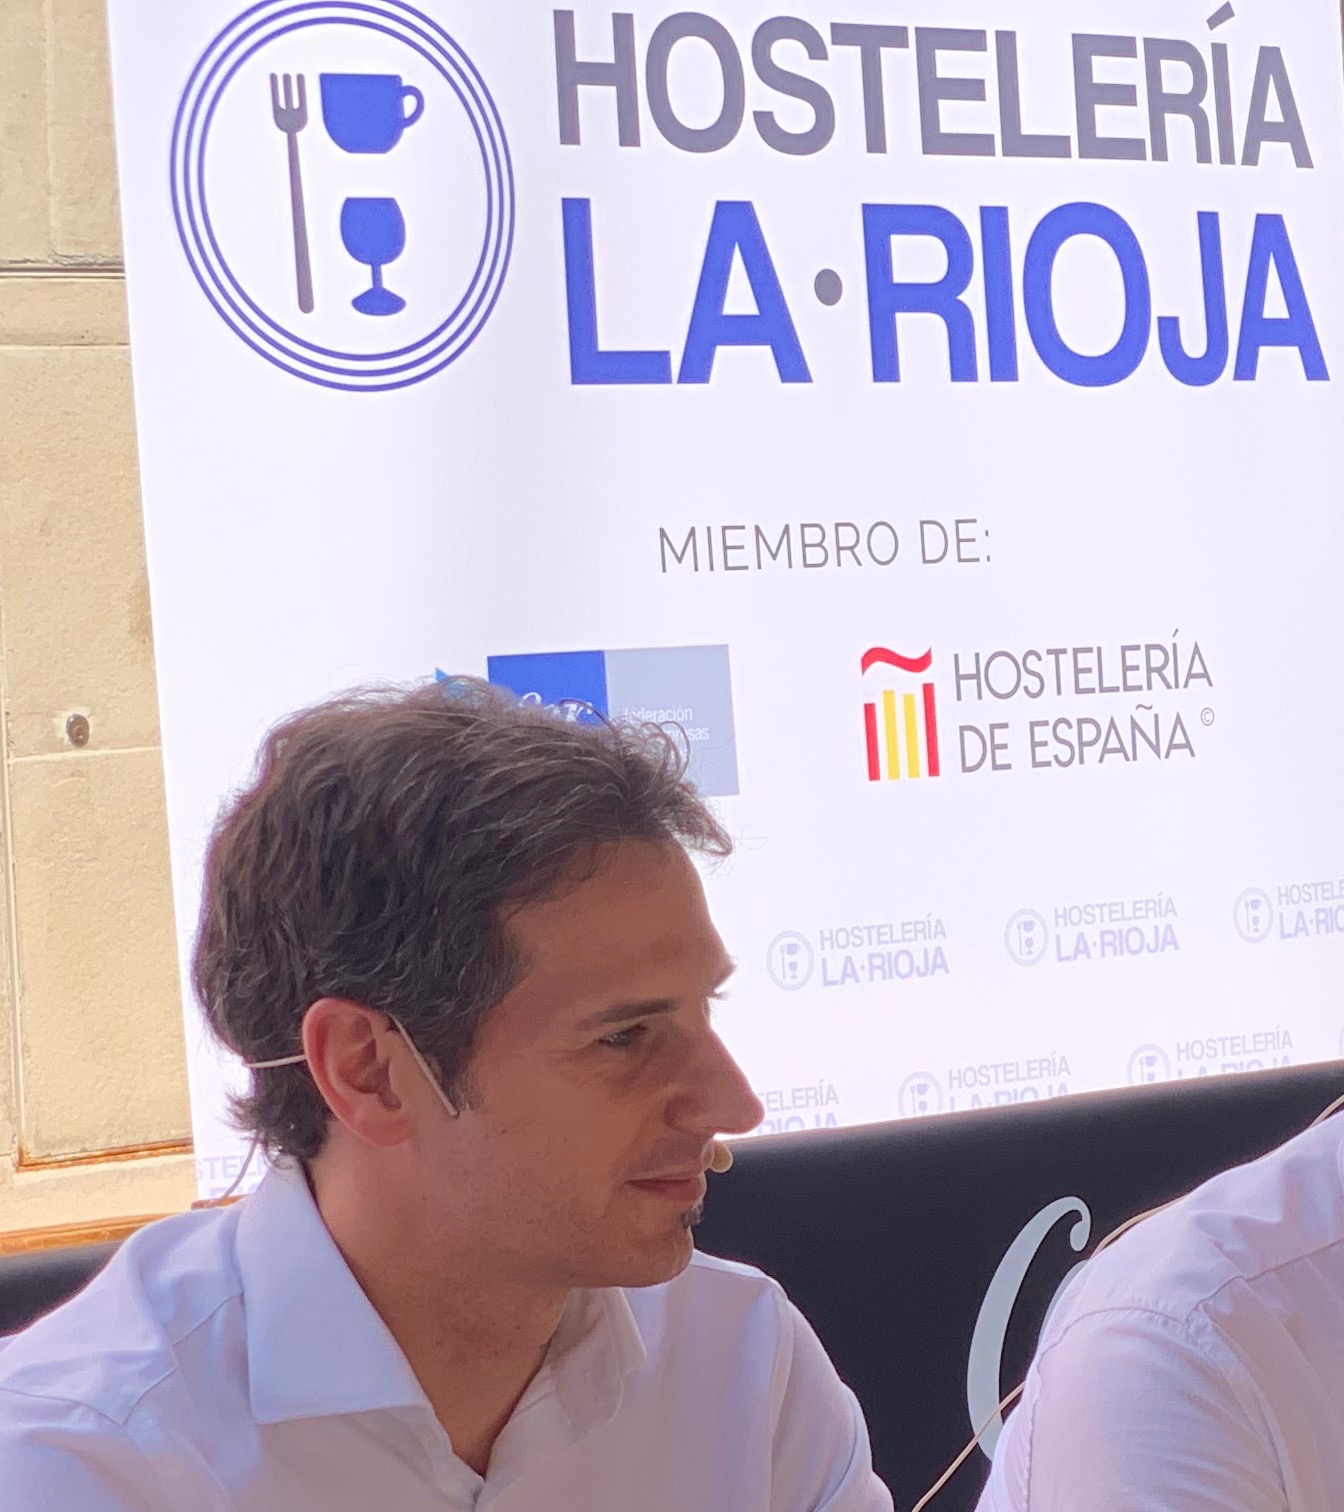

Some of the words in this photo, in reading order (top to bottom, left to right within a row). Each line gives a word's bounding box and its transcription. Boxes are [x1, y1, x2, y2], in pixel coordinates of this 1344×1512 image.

[553, 1, 1314, 169] HOSTELERÍA
[659, 521, 900, 573] MIEMBRO
[919, 518, 992, 564] DE:
[953, 628, 1214, 702] HOSTELERÍA
[958, 722, 1012, 773] DE
[820, 913, 948, 950] HOSTELERÍA
[1054, 892, 1178, 928] HOSTELERÍA
[1176, 1025, 1294, 1062] HOSTELERÍA
[948, 1050, 1072, 1090] HOSTELERÍA
